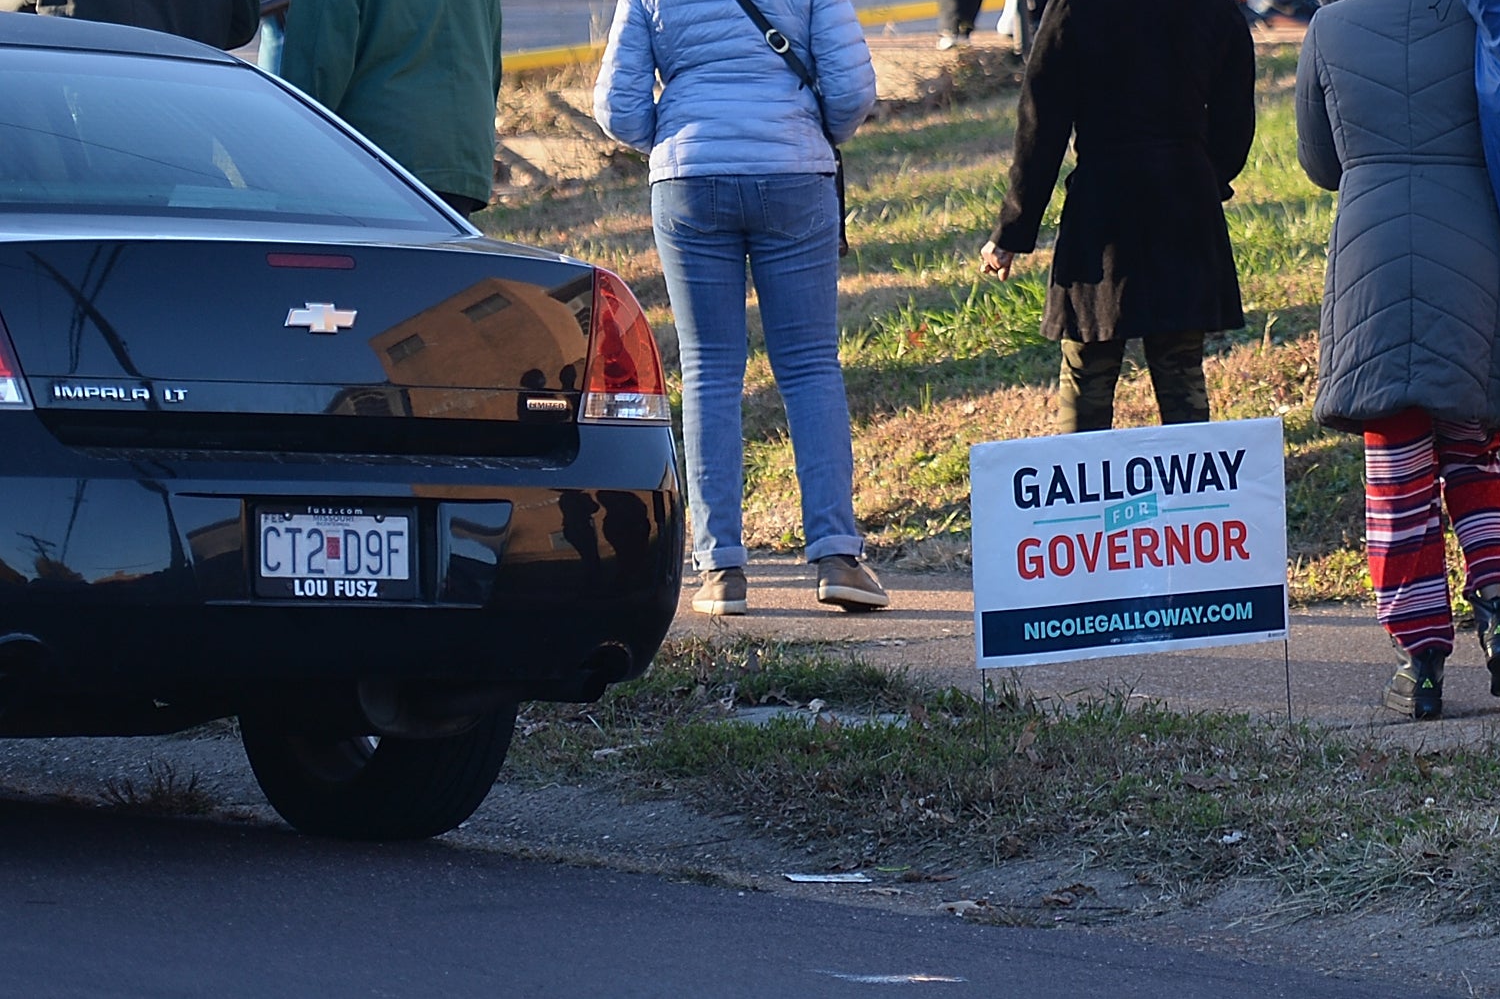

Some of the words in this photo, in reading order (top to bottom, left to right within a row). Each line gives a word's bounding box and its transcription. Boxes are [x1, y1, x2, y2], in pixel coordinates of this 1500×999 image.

[54, 385, 151, 401] IMPALA
[164, 389, 189, 403] LT
[1013, 449, 1246, 510] GALLOWAY
[307, 506, 364, 515] fusz.com
[1112, 502, 1149, 524] FOR
[264, 526, 325, 574] CT2
[343, 529, 404, 576] D9F
[1016, 520, 1250, 581] GOVERNOR
[294, 579, 328, 596] LOU
[334, 580, 378, 598] FUSZ
[1024, 602, 1253, 641] NICOLEGALLOWAY.COM
